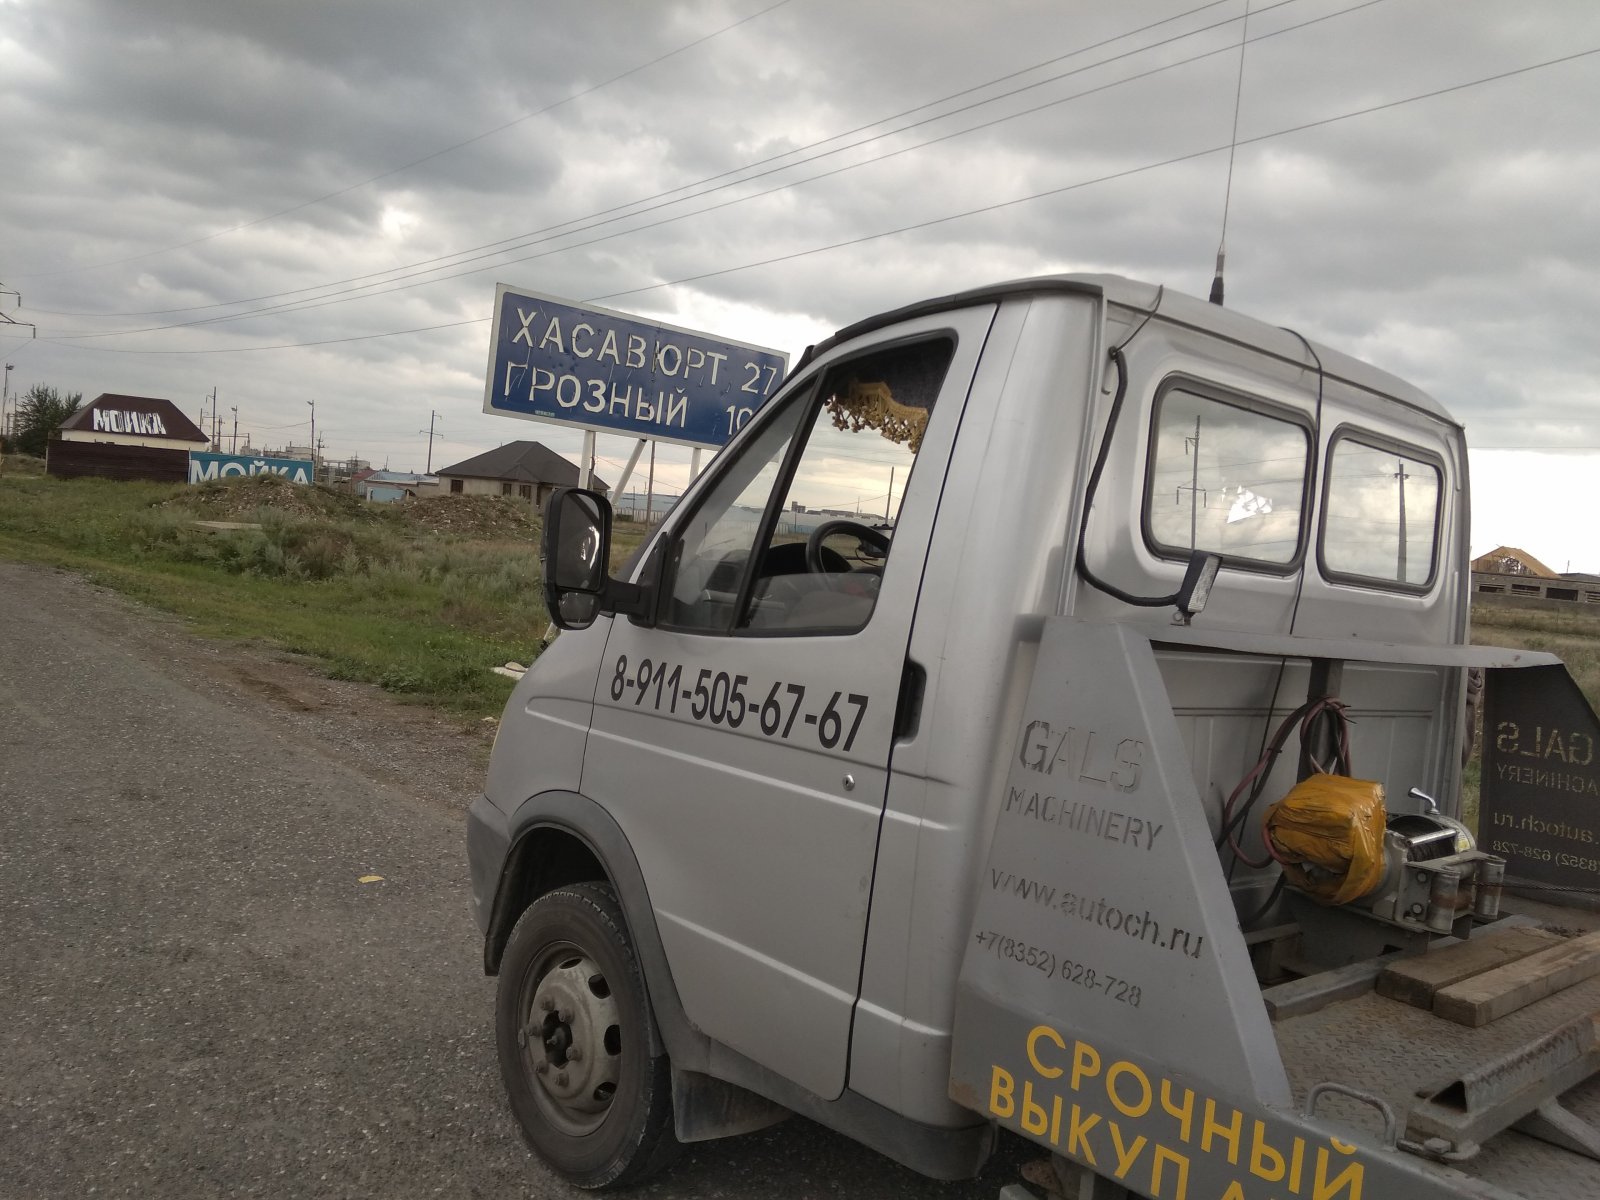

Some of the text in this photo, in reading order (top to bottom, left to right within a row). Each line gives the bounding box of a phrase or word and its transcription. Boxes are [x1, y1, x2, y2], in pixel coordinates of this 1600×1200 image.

[503, 361, 689, 428] ГРОЗНЫЙ
[512, 307, 778, 395] ХАСАВЮРТ 27
[610, 654, 869, 752] 8-911-505-67-67
[1019, 720, 1145, 795] GALS
[1006, 786, 1164, 850] MACHINERY
[991, 868, 1205, 959] www.autoch.ru
[975, 930, 1142, 1008] +7(8352) 628-728
[989, 1065, 1190, 1200] ВЫКУП
[1026, 1025, 1365, 1200] СРОЧНЫЙ
